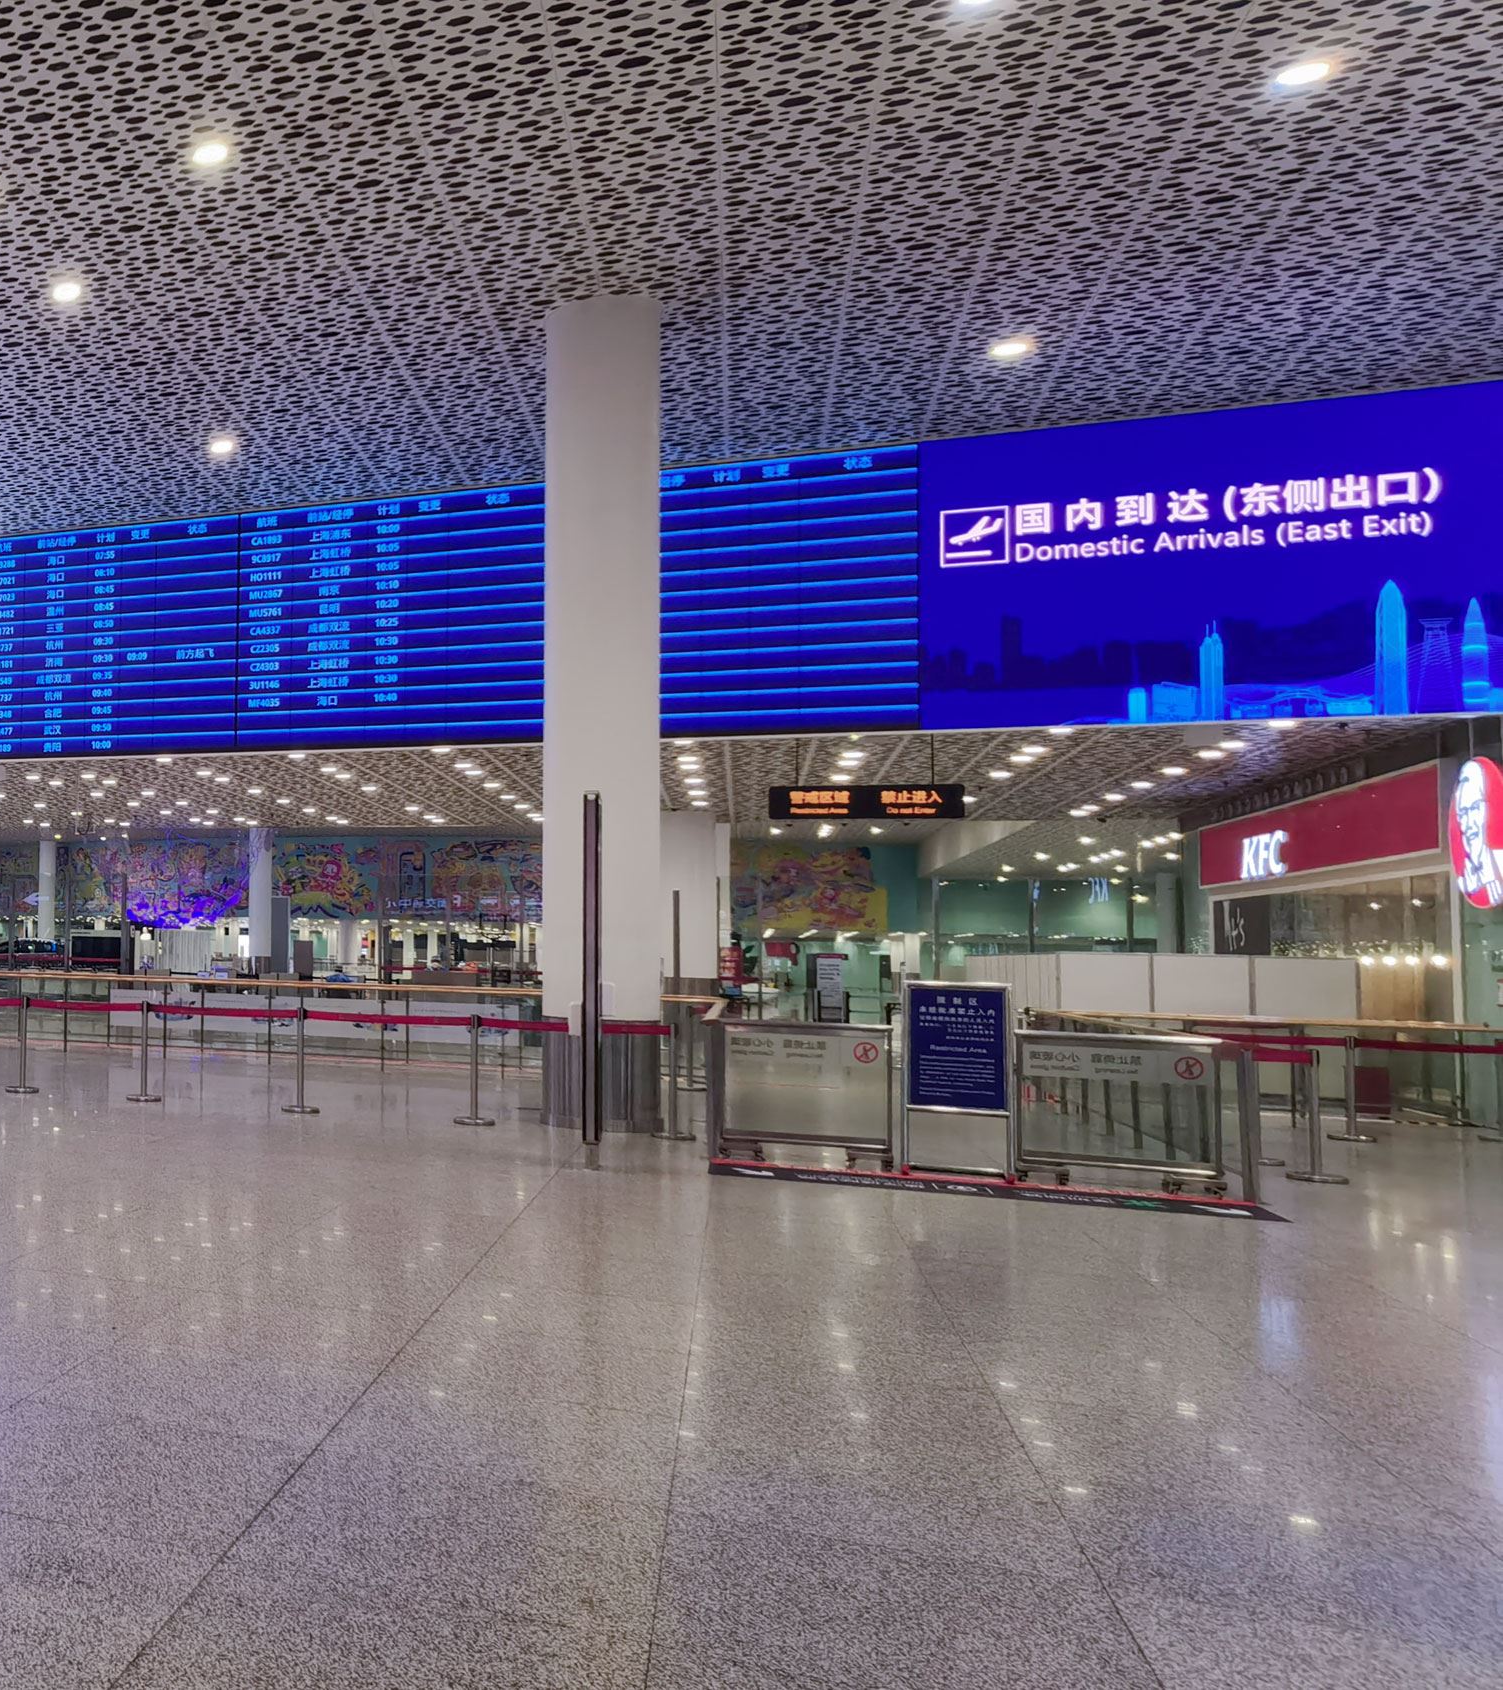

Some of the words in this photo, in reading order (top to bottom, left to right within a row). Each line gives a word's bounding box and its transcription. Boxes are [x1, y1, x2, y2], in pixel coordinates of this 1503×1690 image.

[1015, 534, 1145, 563] Domestic
[1153, 524, 1265, 553] Arrivals
[1276, 519, 1352, 547] (East
[1363, 511, 1433, 537] Exit)
[376, 542, 400, 553] 10:05
[250, 571, 282, 582] HO1111
[375, 561, 399, 572] 10:05
[249, 607, 282, 618] MU5761
[374, 617, 398, 628] 10:25
[374, 636, 398, 646] 10:30
[317, 696, 338, 707] 海口
[881, 790, 943, 804] 禁止进入
[1240, 829, 1289, 880] KFC
